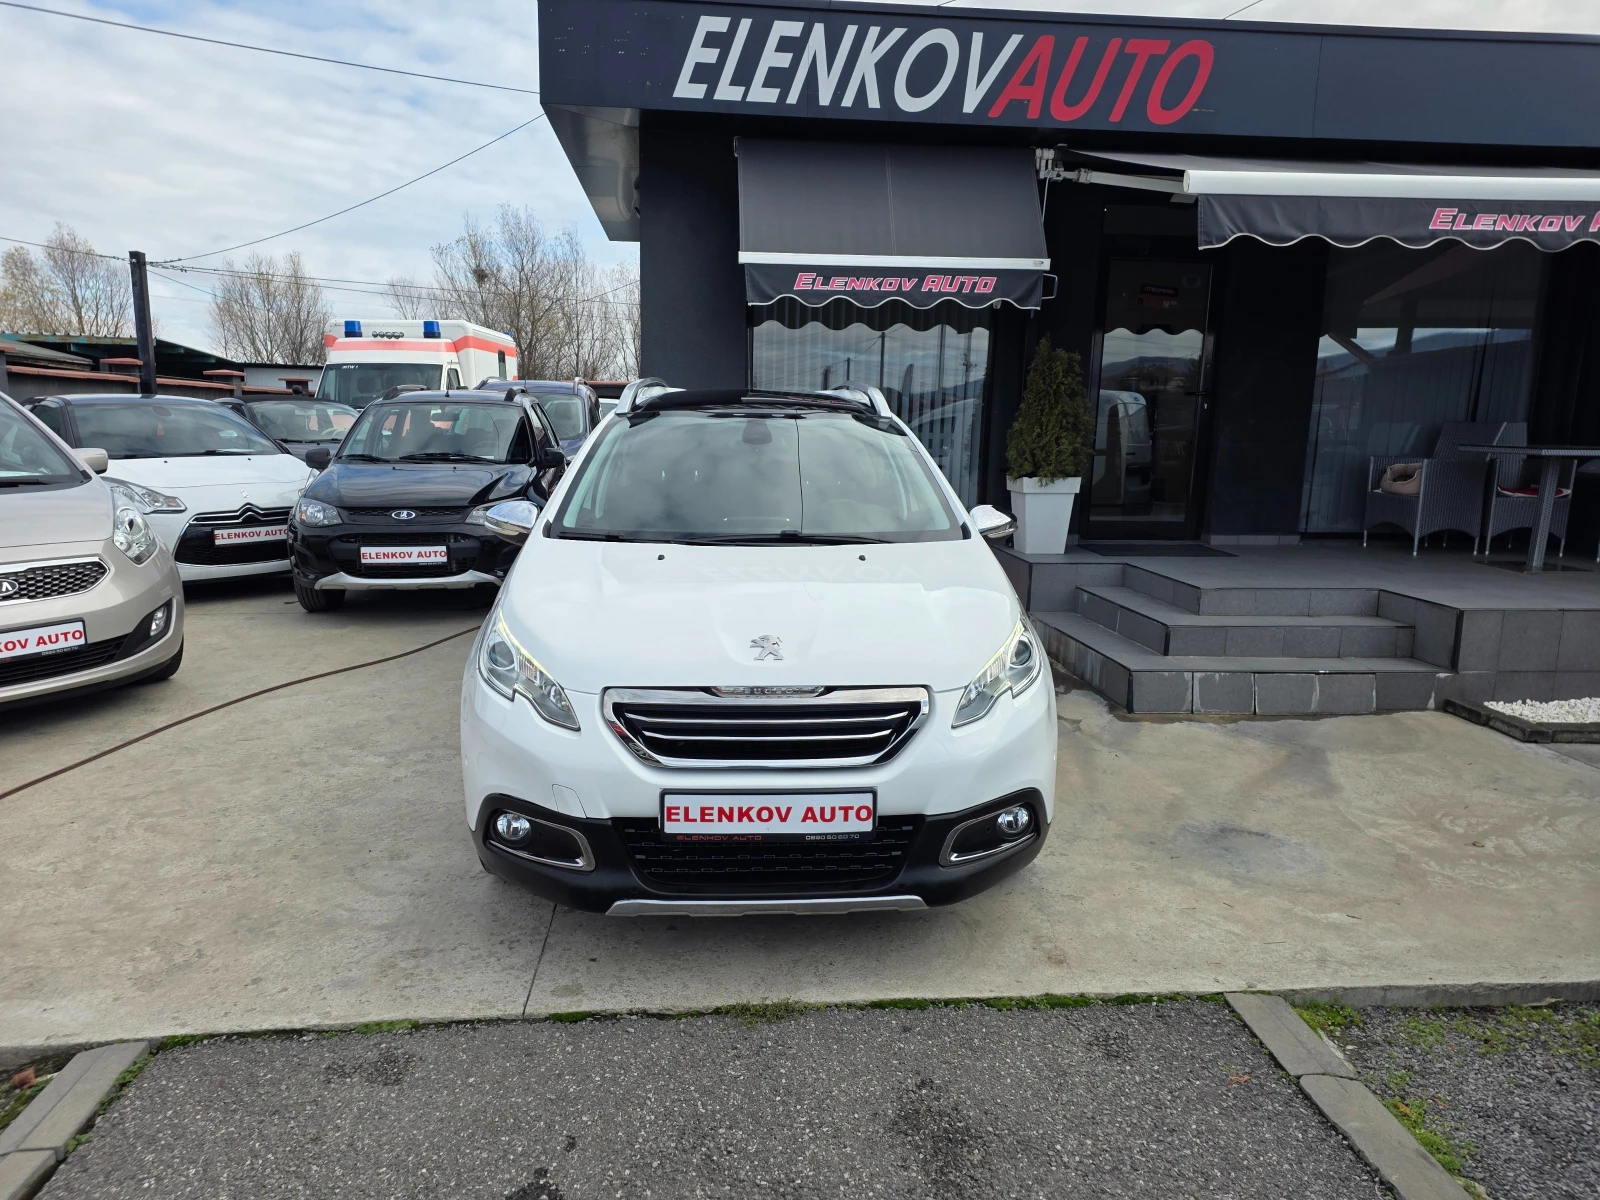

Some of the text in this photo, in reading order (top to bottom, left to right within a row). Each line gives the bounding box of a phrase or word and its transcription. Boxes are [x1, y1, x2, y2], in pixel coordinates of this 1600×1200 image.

[1429, 207, 1586, 232] ELENKOV
[794, 272, 998, 293] ELENKOV AUTO
[213, 530, 261, 540] ELENKOV
[361, 550, 447, 560] ELENKOV AUTO
[36, 629, 83, 647] AUTO
[666, 805, 873, 823] ELENKOV AUTO
